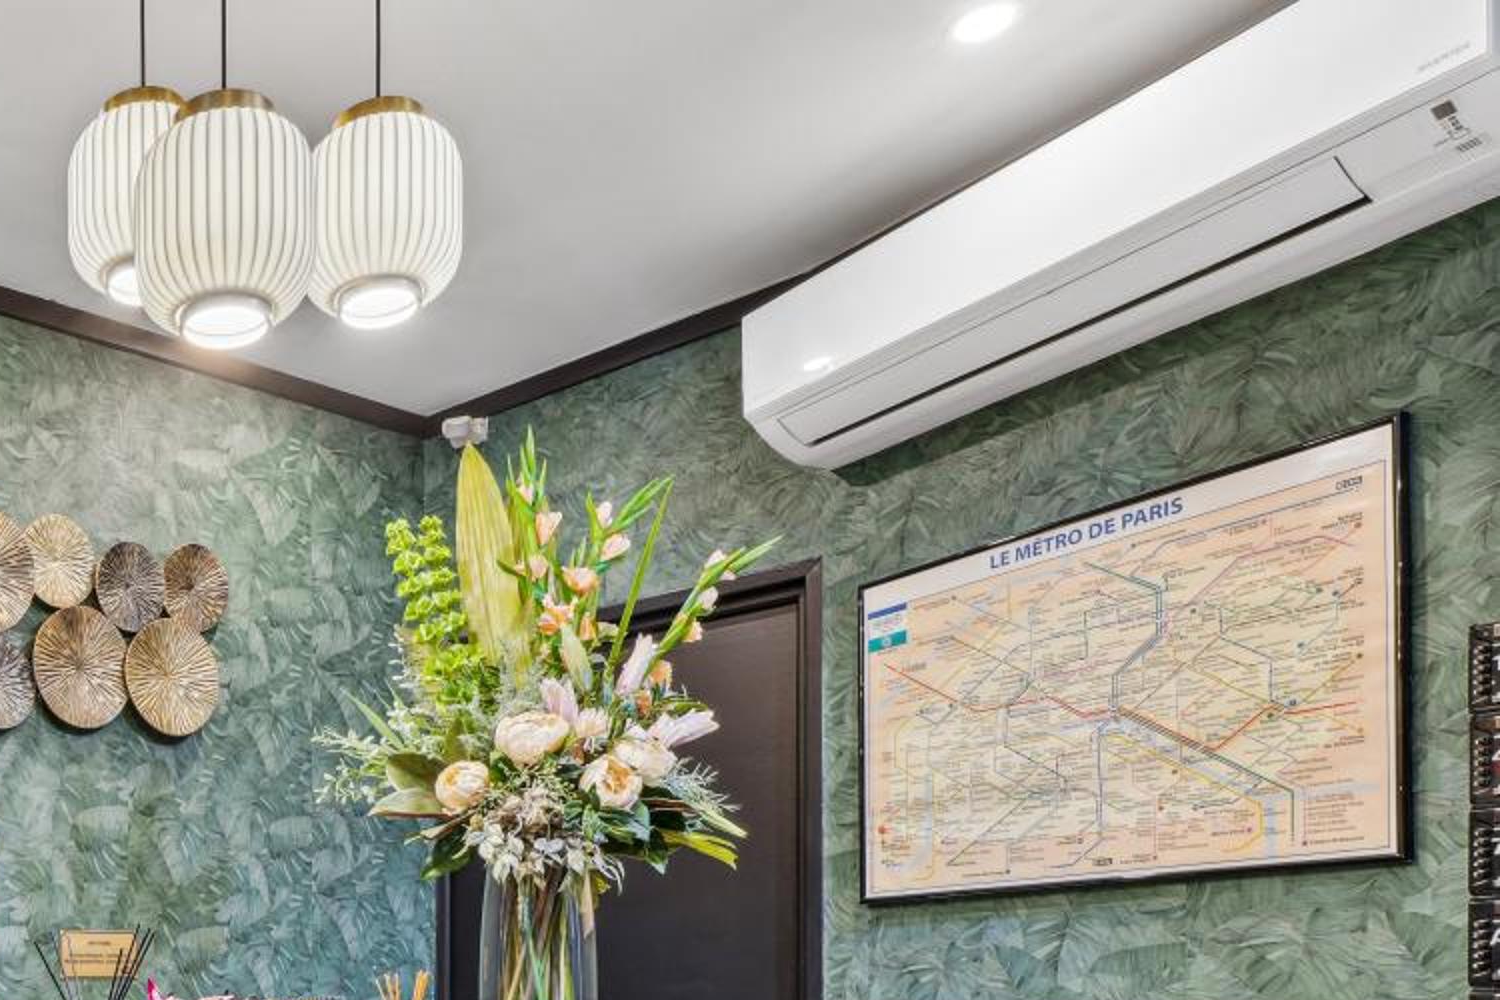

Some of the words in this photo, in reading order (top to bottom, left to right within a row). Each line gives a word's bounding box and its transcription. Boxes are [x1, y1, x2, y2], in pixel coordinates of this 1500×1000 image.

[989, 551, 1011, 570] LE
[1088, 518, 1115, 540] DE
[1121, 497, 1184, 529] PARIS
